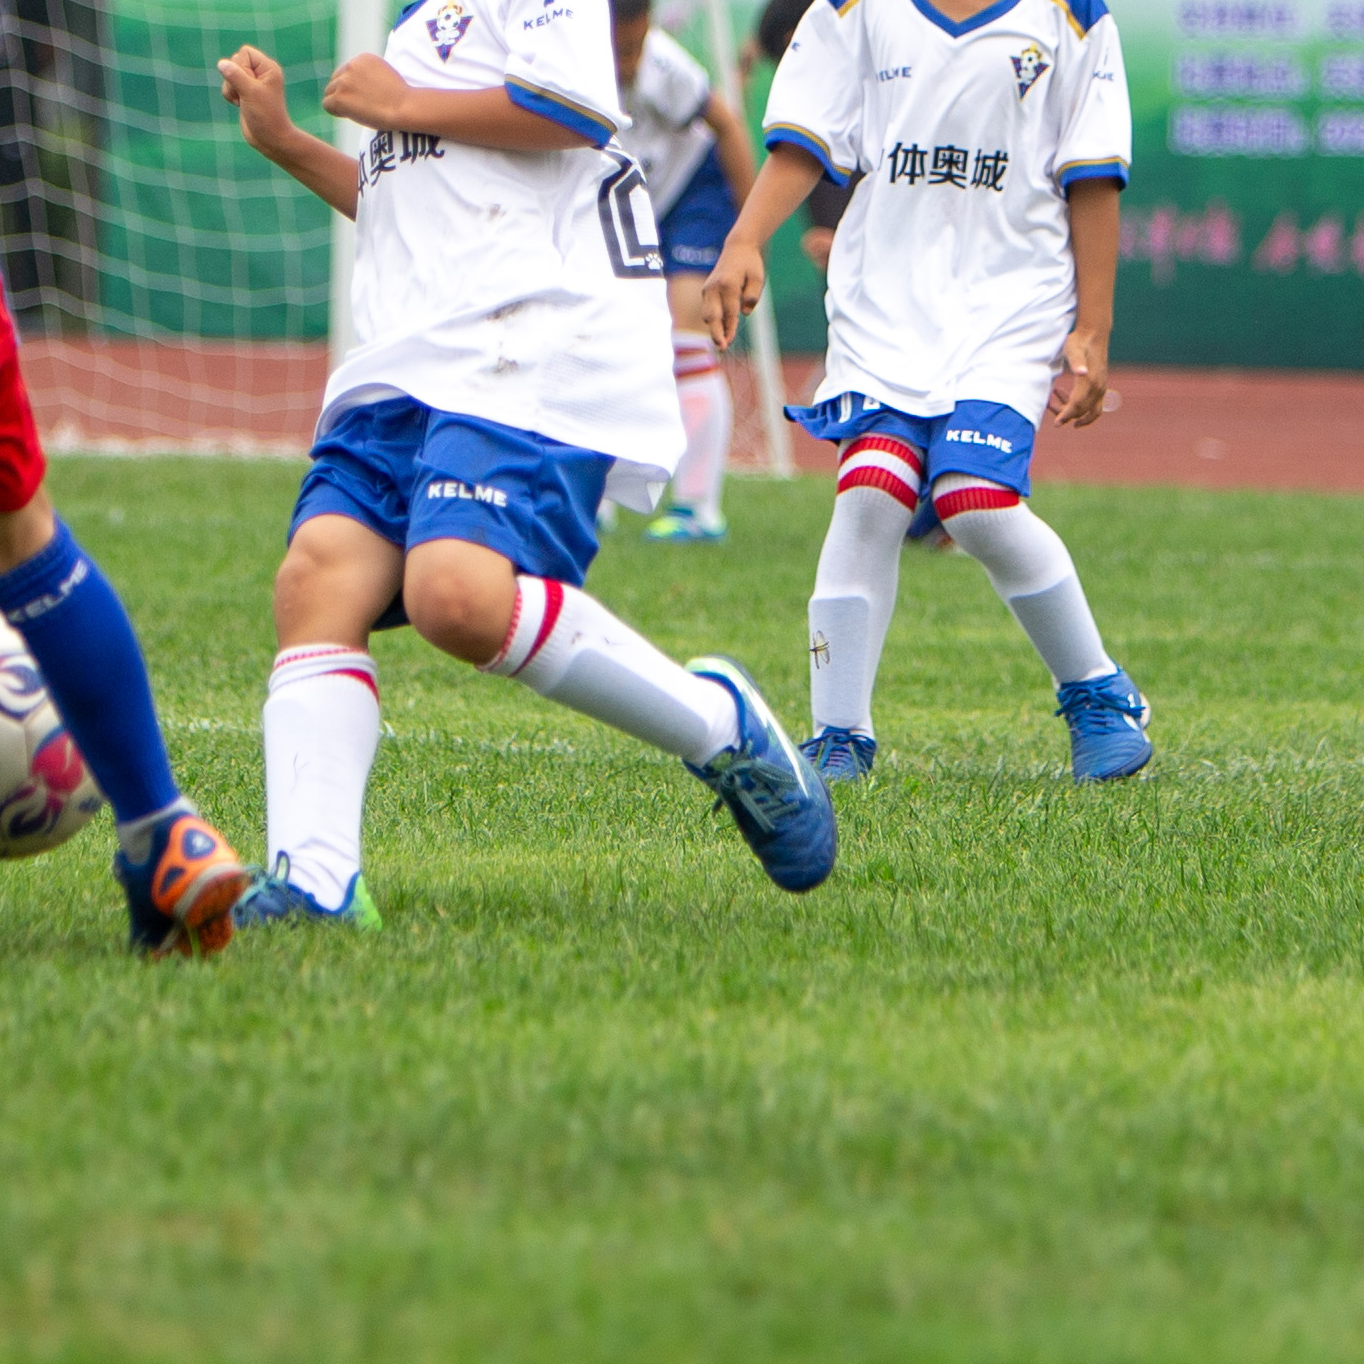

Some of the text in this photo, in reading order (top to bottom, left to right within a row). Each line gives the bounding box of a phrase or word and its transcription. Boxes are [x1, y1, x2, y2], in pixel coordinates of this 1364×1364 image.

[523, 7, 574, 30] KELME
[876, 66, 912, 83] ELE
[877, 142, 1008, 191] 体奥城
[946, 429, 1012, 453] KELME
[428, 481, 507, 507] KELME
